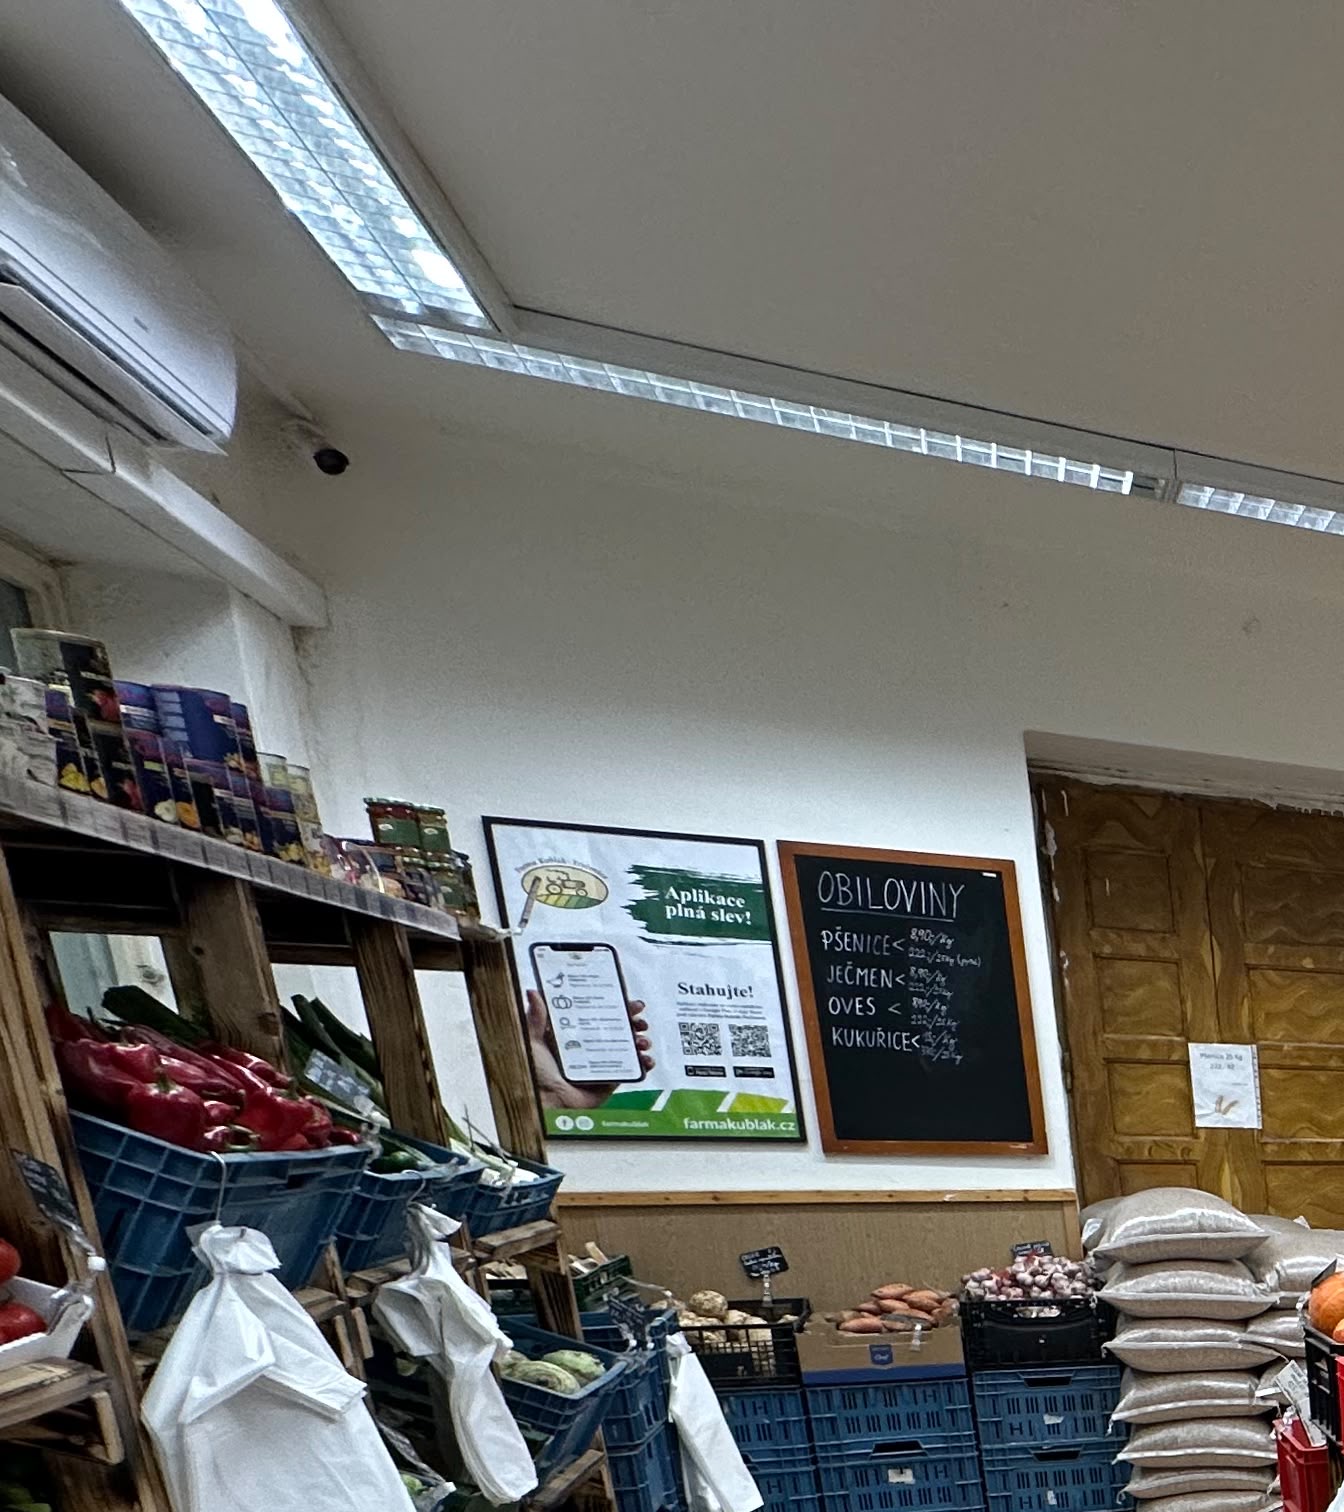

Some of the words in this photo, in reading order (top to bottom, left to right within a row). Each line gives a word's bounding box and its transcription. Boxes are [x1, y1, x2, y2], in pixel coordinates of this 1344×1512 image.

[664, 886, 745, 908] Aplikace
[817, 870, 965, 918] OBILOVINY
[665, 906, 706, 921] plná
[710, 910, 752, 926] slev!
[821, 926, 891, 956] PŠENICE
[826, 961, 893, 989] JEČMEN
[677, 981, 754, 1000] Stahujte!
[828, 996, 876, 1016] OVES
[832, 1026, 913, 1051] KUKUŘICE
[683, 1117, 796, 1132] farmakublak.cz
